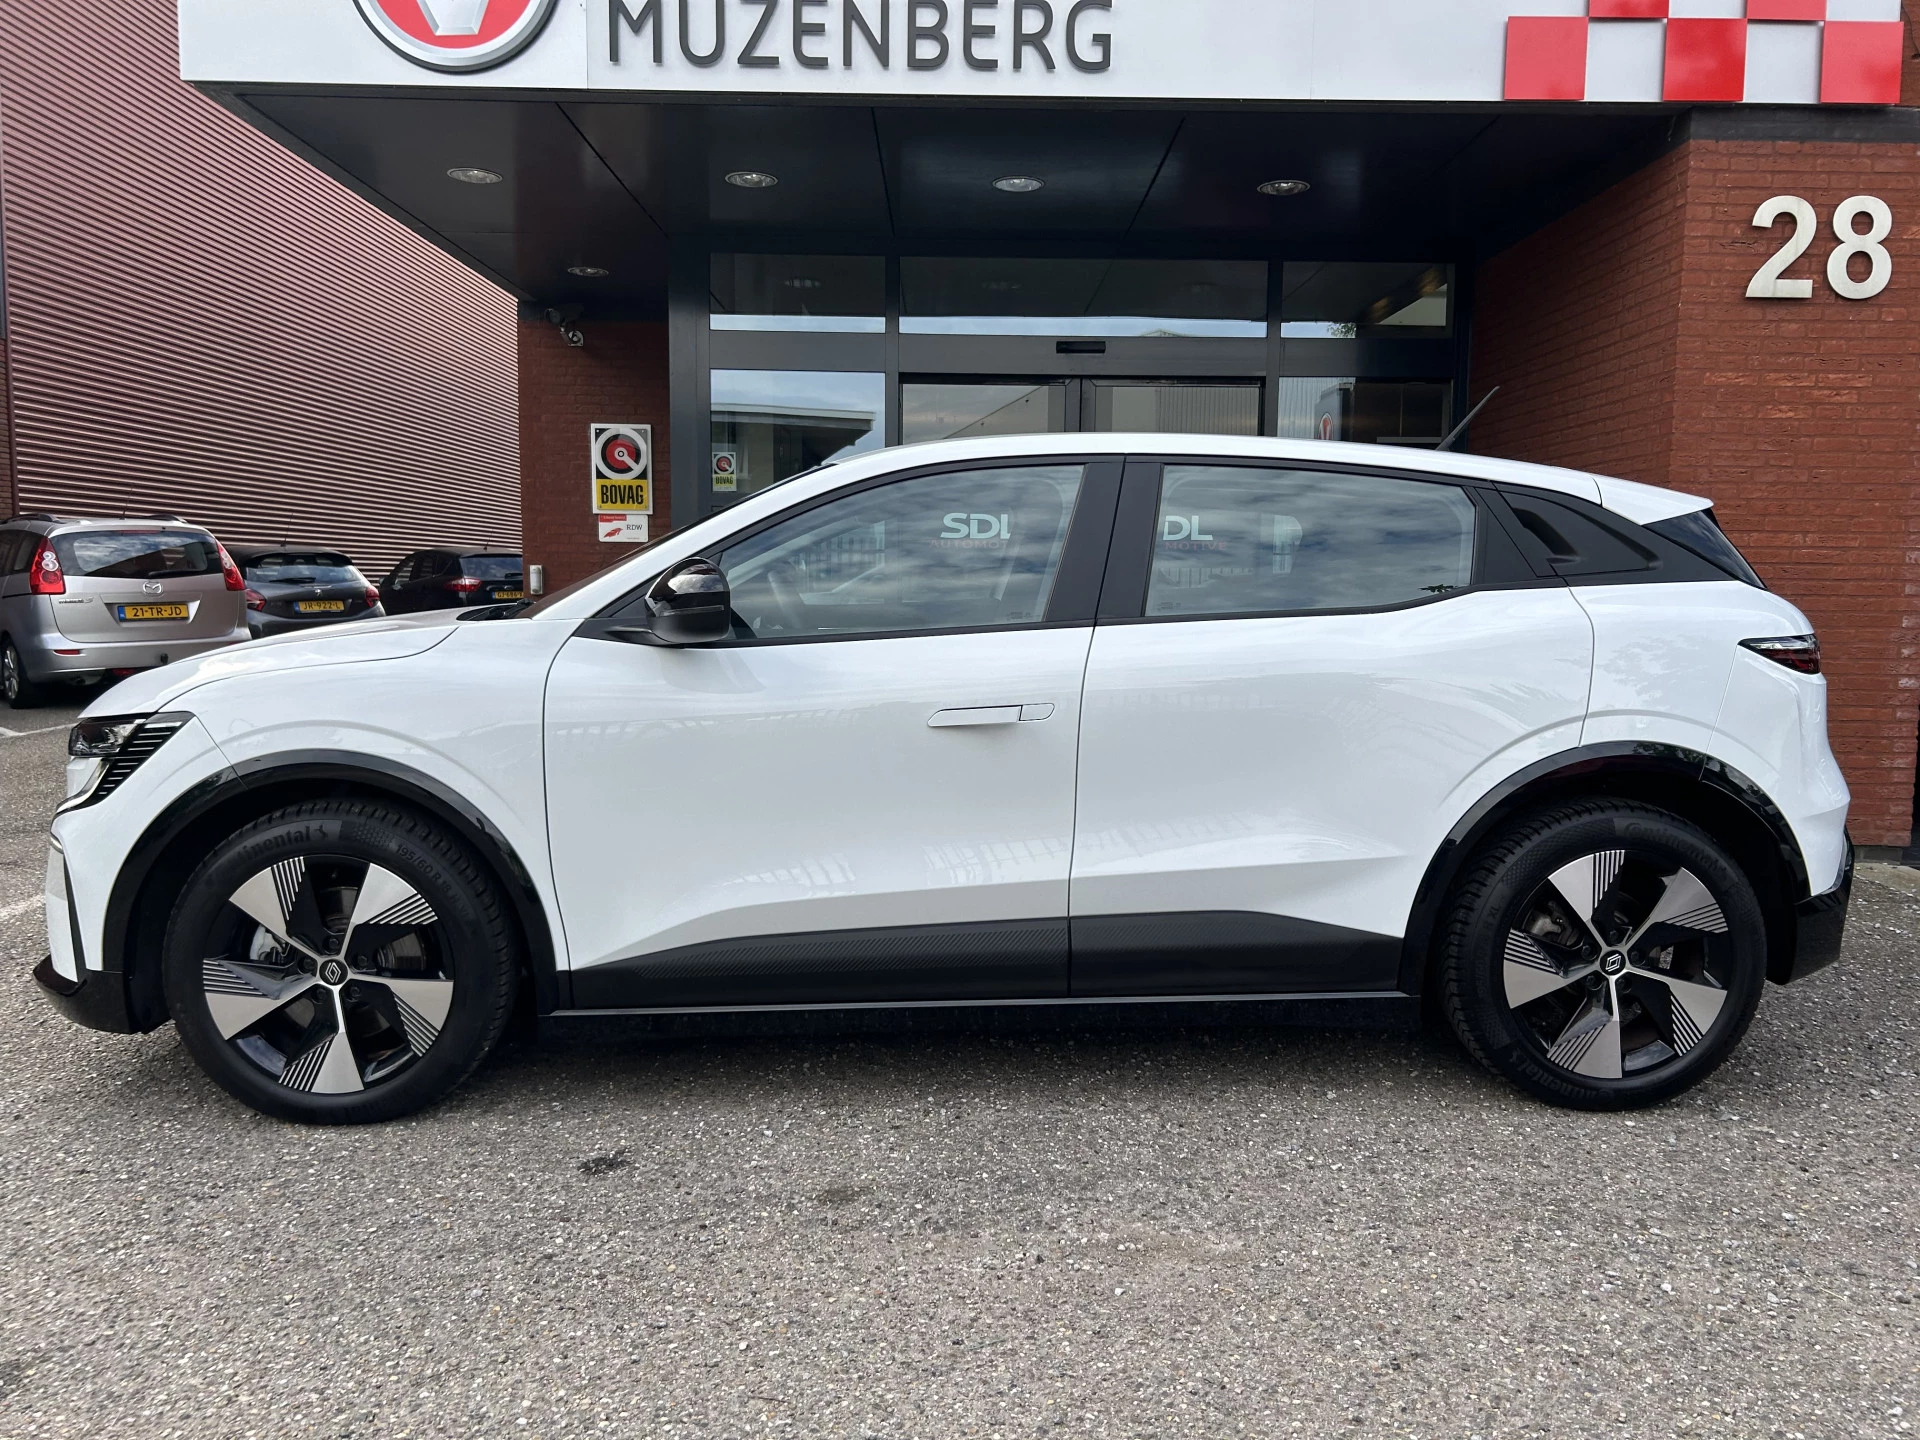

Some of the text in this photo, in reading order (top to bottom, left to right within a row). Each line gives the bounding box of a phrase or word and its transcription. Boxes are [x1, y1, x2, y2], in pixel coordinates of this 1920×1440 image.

[609, 0, 1113, 69] MUZENBERG
[1745, 195, 1893, 299] 28
[715, 475, 734, 485] BOVAG
[601, 484, 644, 505] BOVAG
[132, 606, 182, 617] 21-TR-JD
[304, 601, 341, 610] JR-922-L
[397, 843, 434, 874] 195/60
